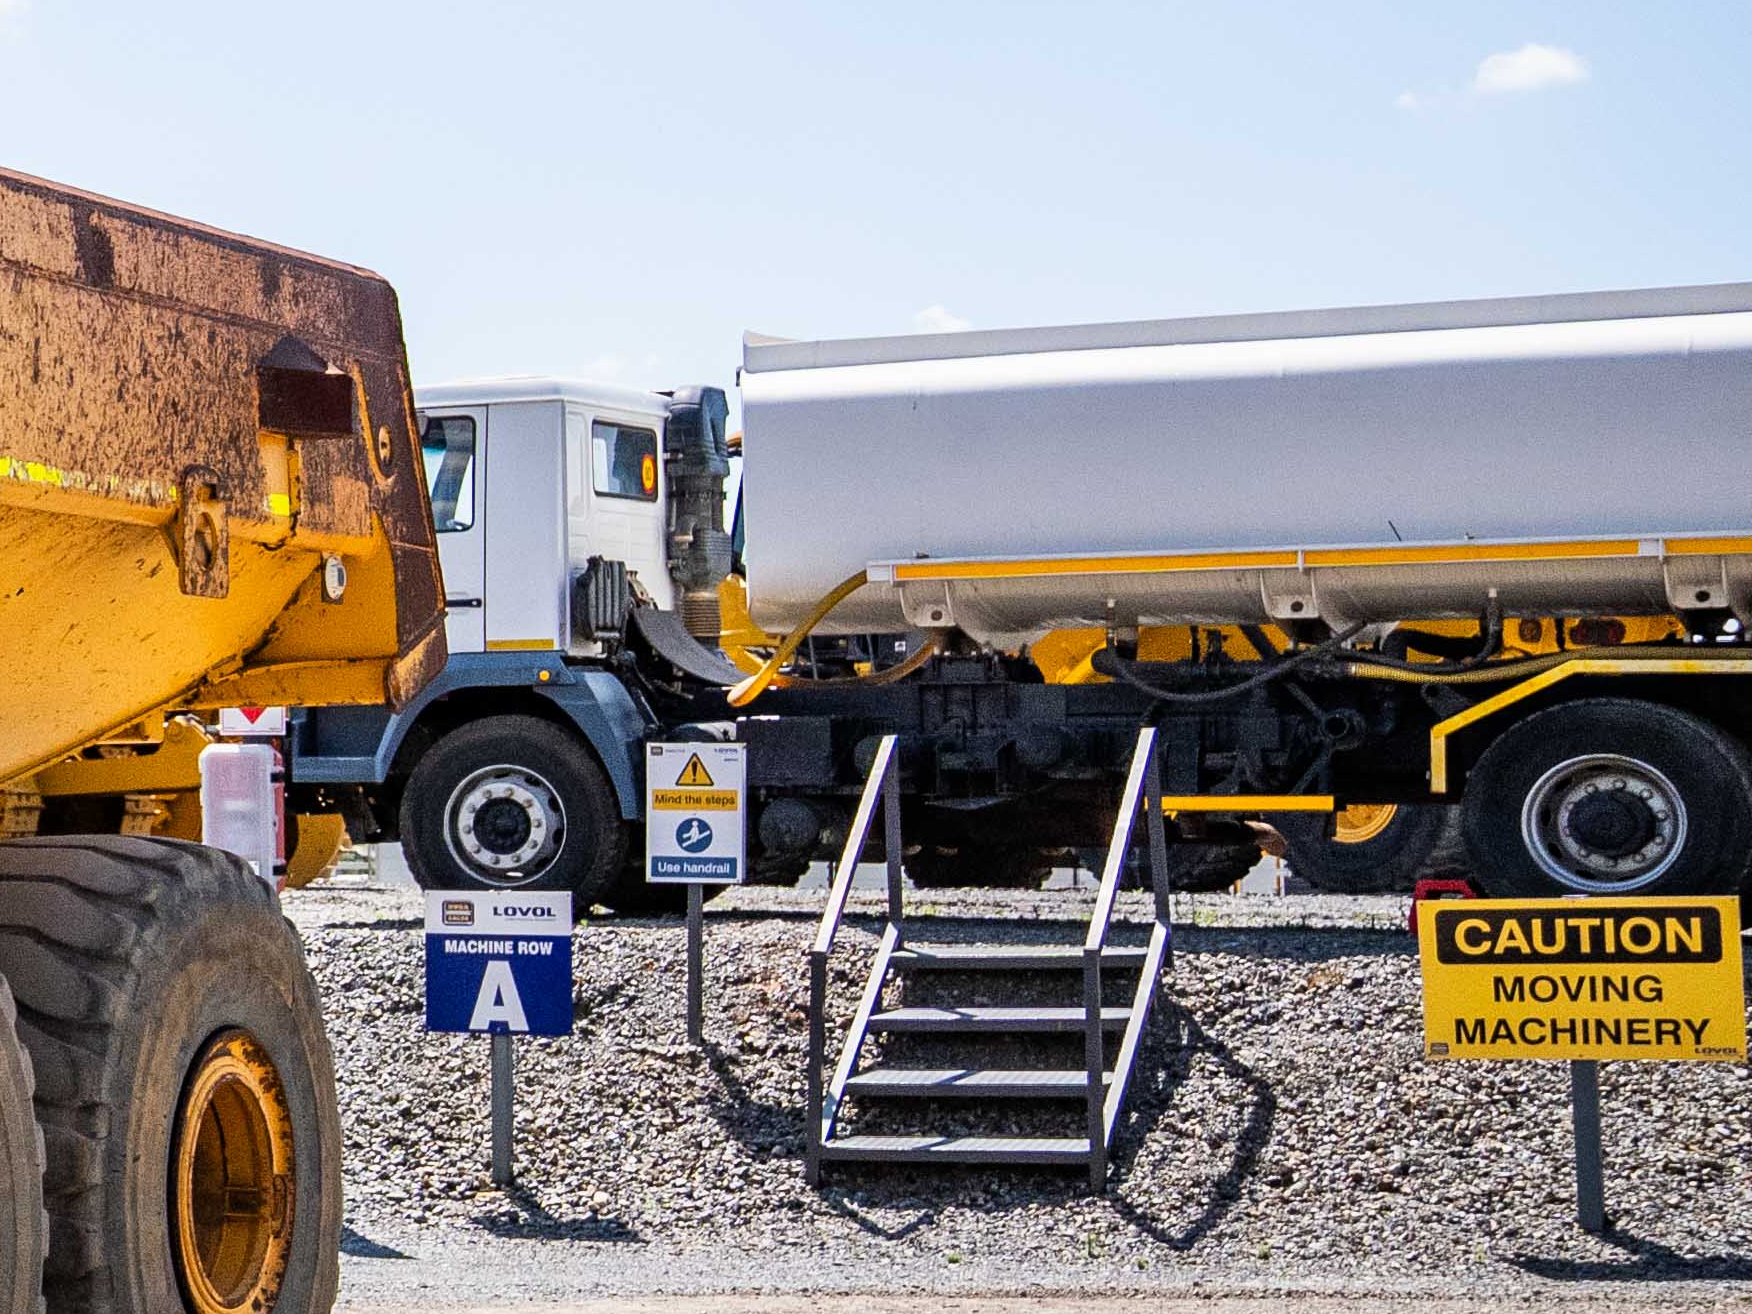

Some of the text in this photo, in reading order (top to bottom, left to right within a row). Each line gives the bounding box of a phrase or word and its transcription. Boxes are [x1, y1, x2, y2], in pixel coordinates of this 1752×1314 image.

[655, 794, 735, 807] Mind the steps
[657, 861, 730, 874] Use handrail
[493, 906, 556, 917] LOVOL
[1454, 916, 1703, 955] CAUTION
[444, 939, 553, 955] MACHINE ROW
[469, 960, 530, 1032] A
[1494, 975, 1663, 1003] MOVING
[1454, 1018, 1711, 1046] MACHINERY
